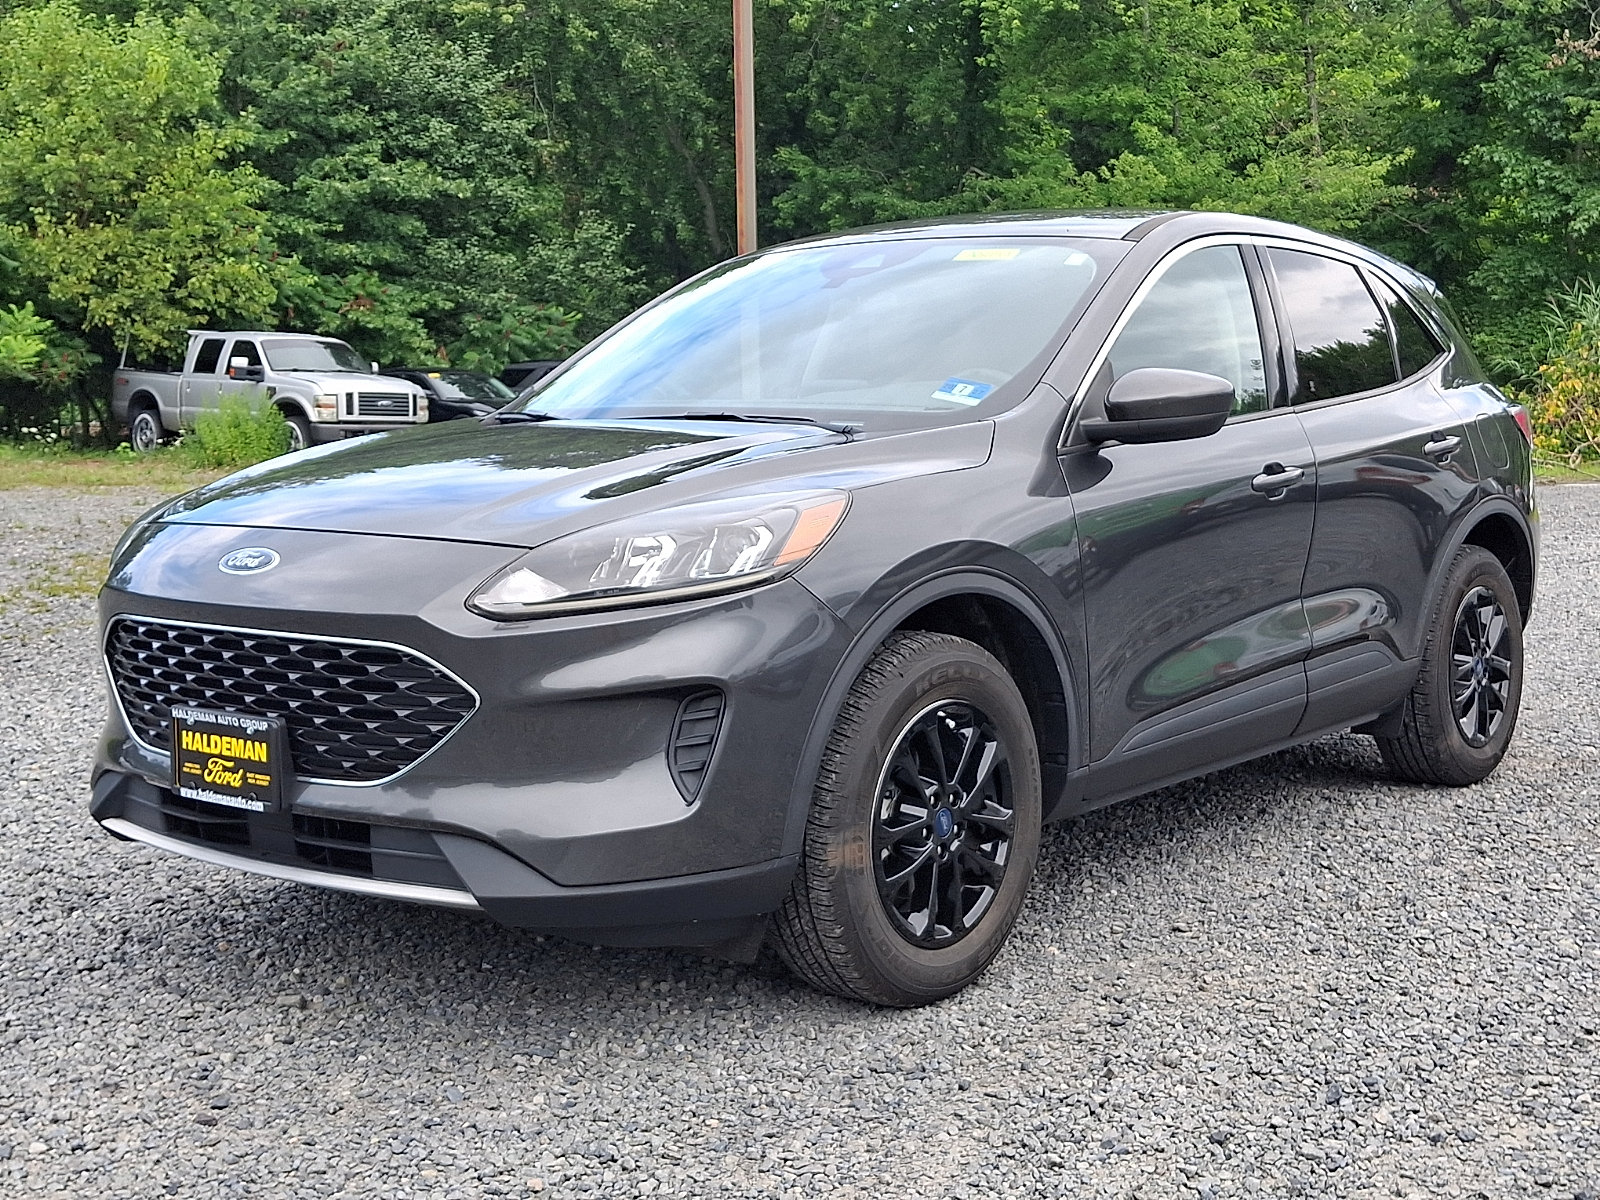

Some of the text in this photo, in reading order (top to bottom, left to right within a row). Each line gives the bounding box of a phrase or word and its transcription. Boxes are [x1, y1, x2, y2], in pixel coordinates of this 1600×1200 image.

[227, 550, 265, 568] Ford
[916, 662, 990, 697] KELLY
[172, 708, 268, 731] HALDEMAN AUTO GROUP
[182, 730, 267, 762] HALDEMAN
[203, 757, 244, 788] Ford
[180, 788, 264, 812] www.haldemanauto.com
